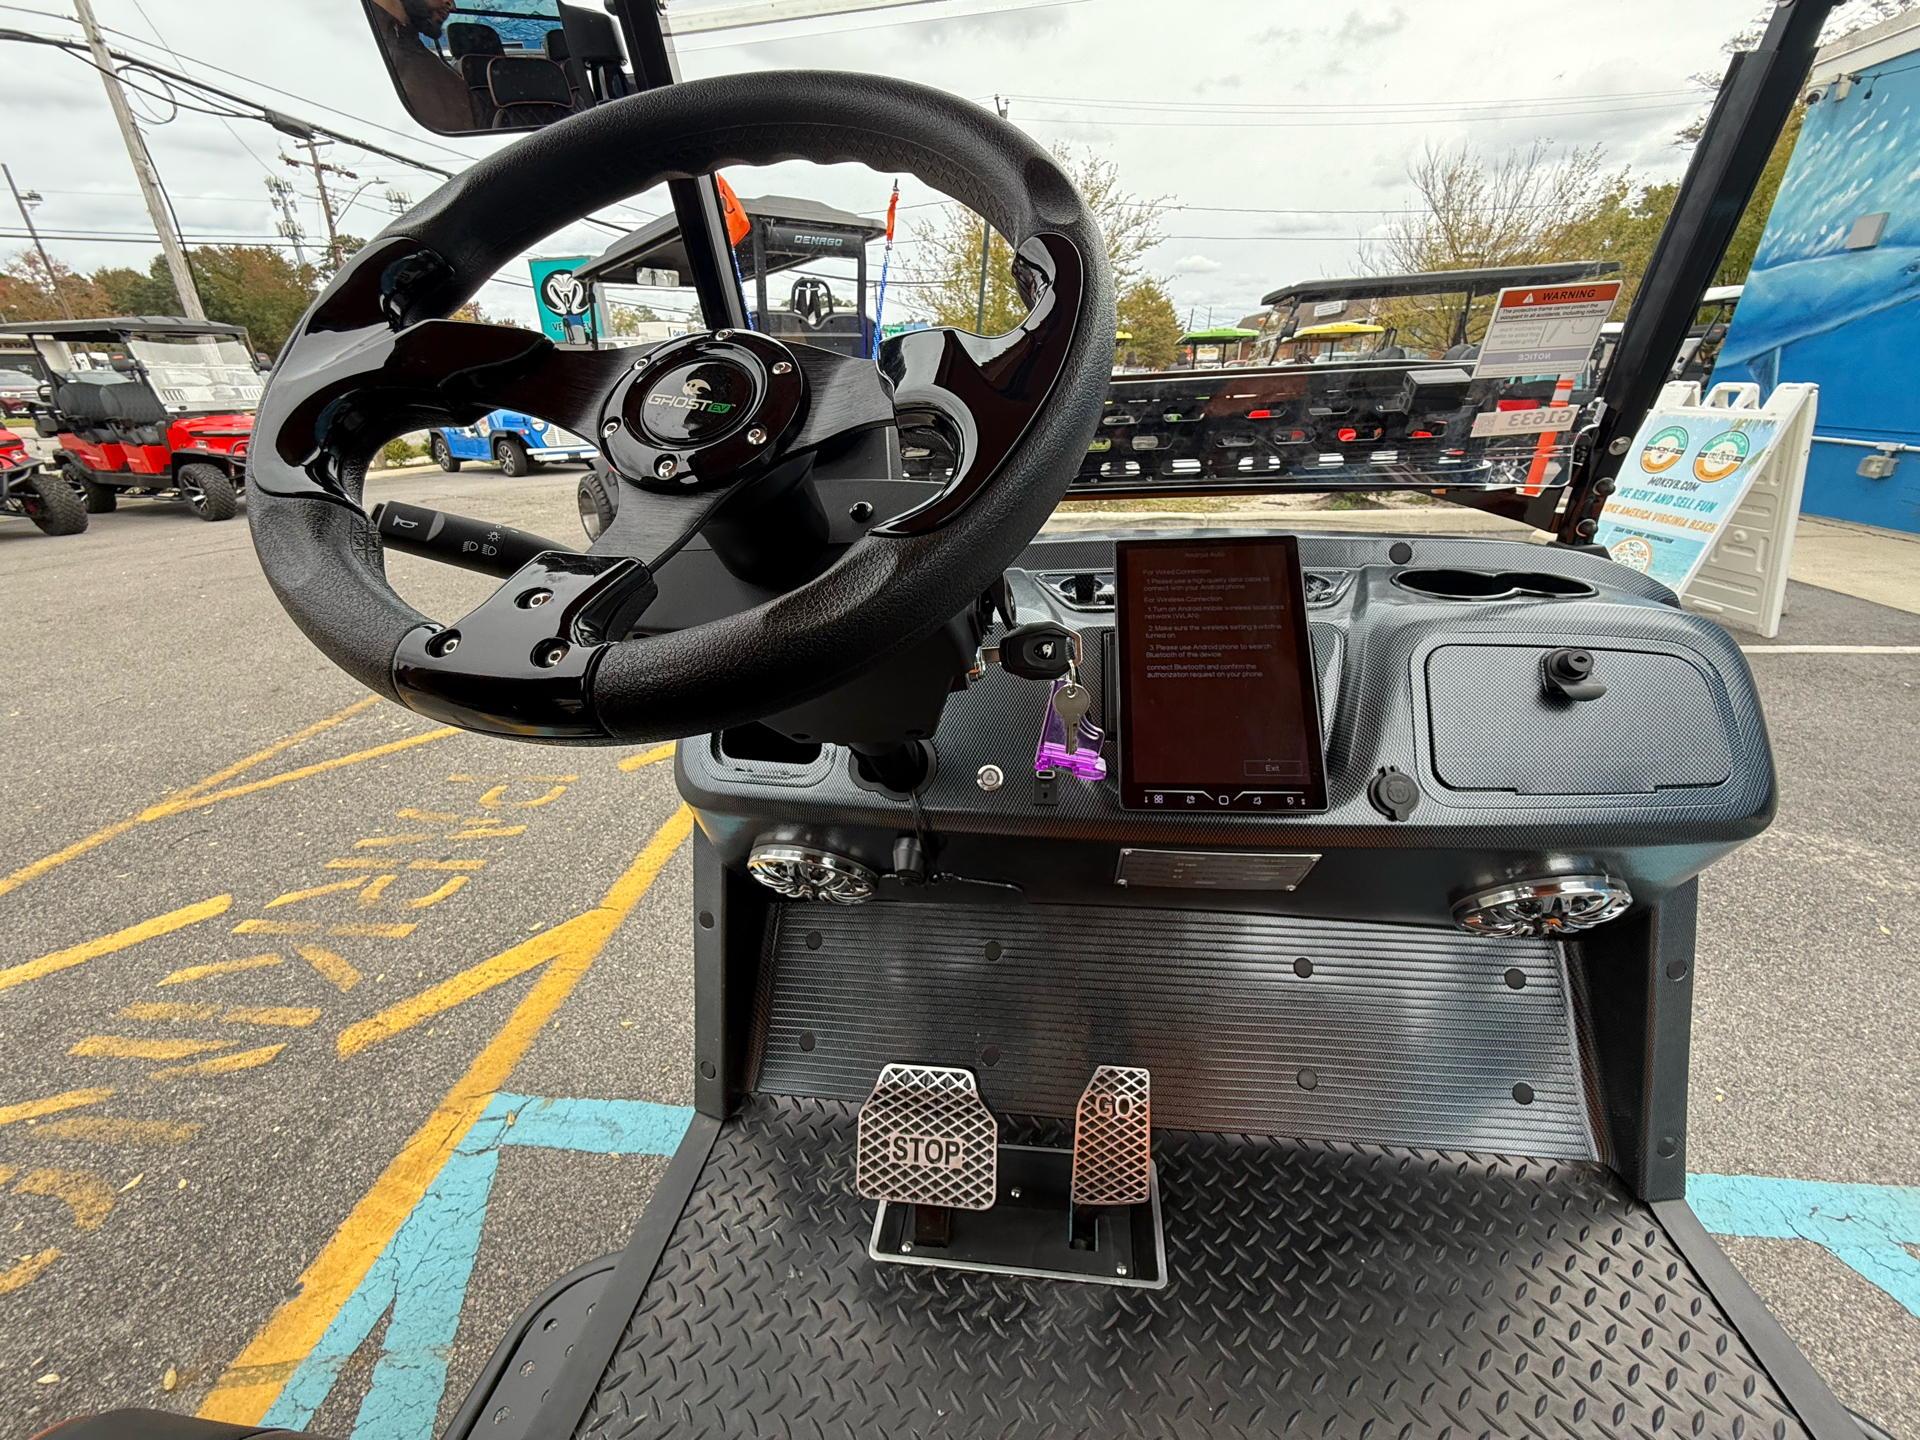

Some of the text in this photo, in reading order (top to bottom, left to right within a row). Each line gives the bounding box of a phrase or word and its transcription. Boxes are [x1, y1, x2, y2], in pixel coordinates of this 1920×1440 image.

[794, 235, 843, 246] DENAGO
[1542, 289, 1596, 301] WARNING
[648, 393, 713, 411] GHOST
[709, 403, 730, 412] EV
[1647, 476, 1700, 492] MOKEVB.COM
[1618, 487, 1718, 514] WE RENT AND SELL FUN
[1619, 506, 1652, 520] AMERICA
[1652, 512, 1689, 528] VIRGINIA
[1688, 519, 1719, 534] BEACH
[1265, 764, 1280, 772] Exit
[1095, 1093, 1133, 1118] GO
[892, 1136, 961, 1165] STOP
